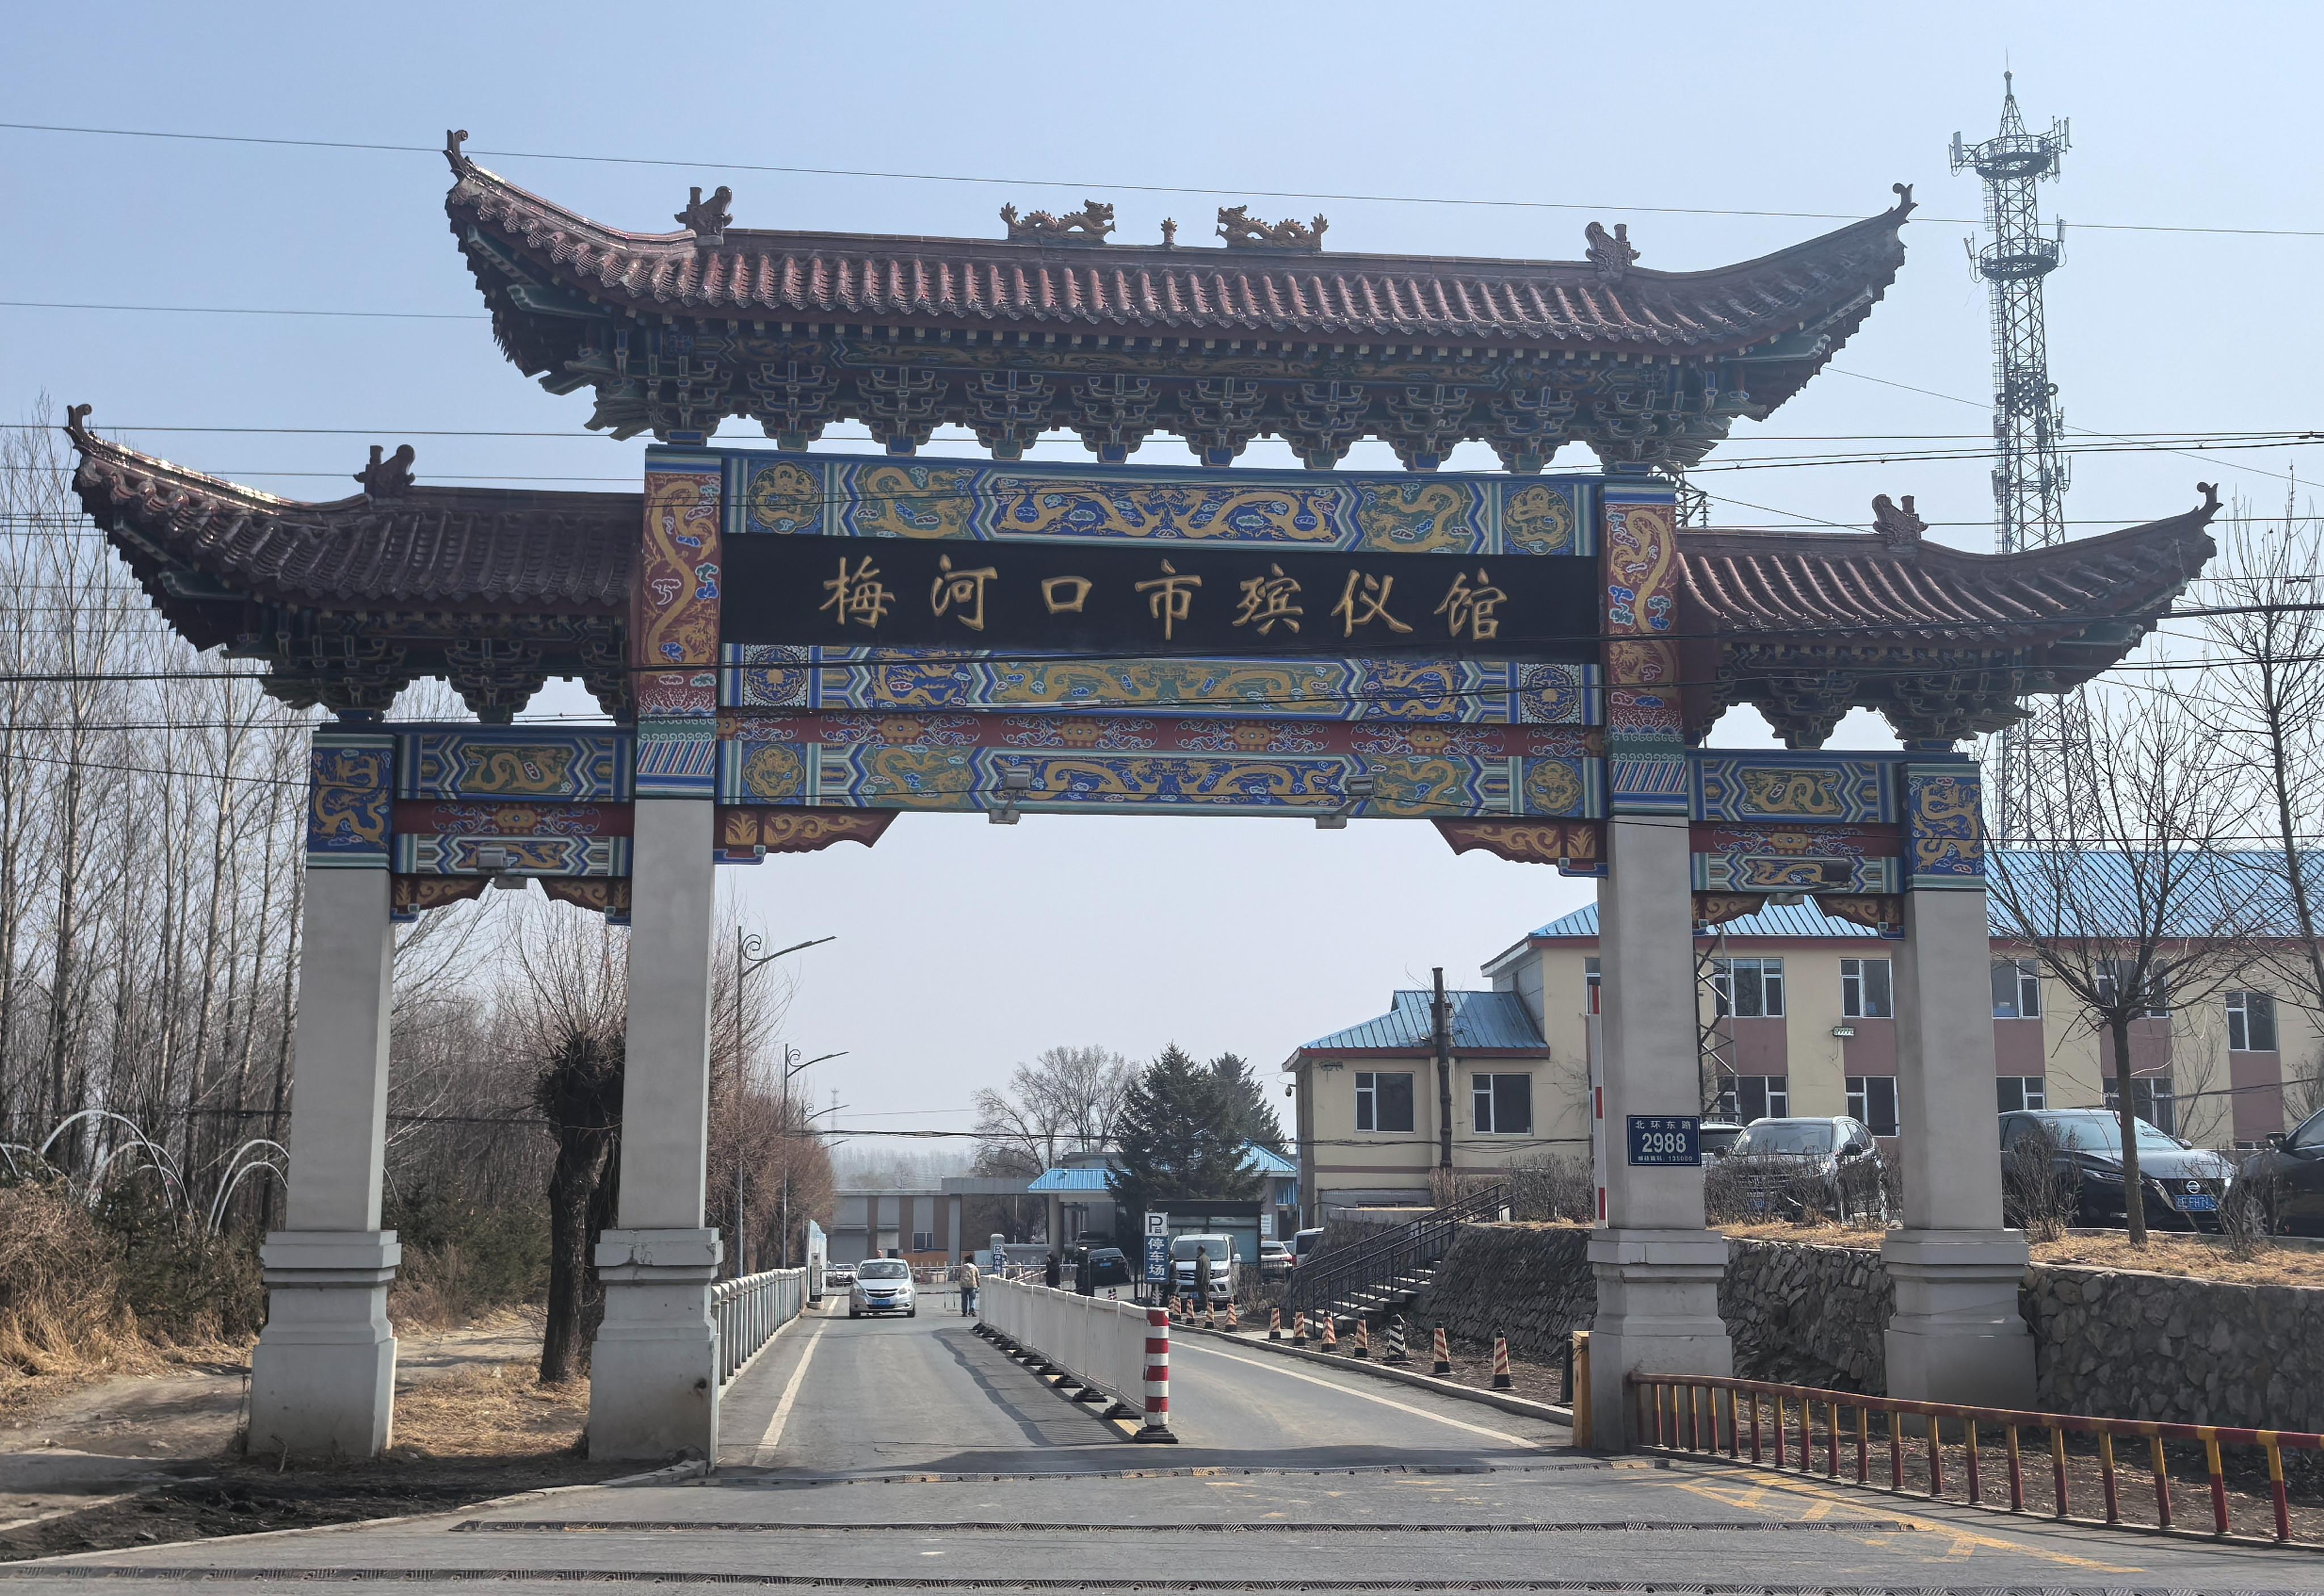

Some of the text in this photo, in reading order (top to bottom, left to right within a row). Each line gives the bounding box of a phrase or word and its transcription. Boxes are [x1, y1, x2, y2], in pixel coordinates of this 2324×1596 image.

[819, 554, 1508, 641] 梅河口市殡仪馆
[1635, 1120, 1691, 1130] 北环东路
[1641, 1132, 1686, 1153] 2988
[1149, 1216, 1163, 1233] P
[1148, 1237, 1165, 1276] 停车场
